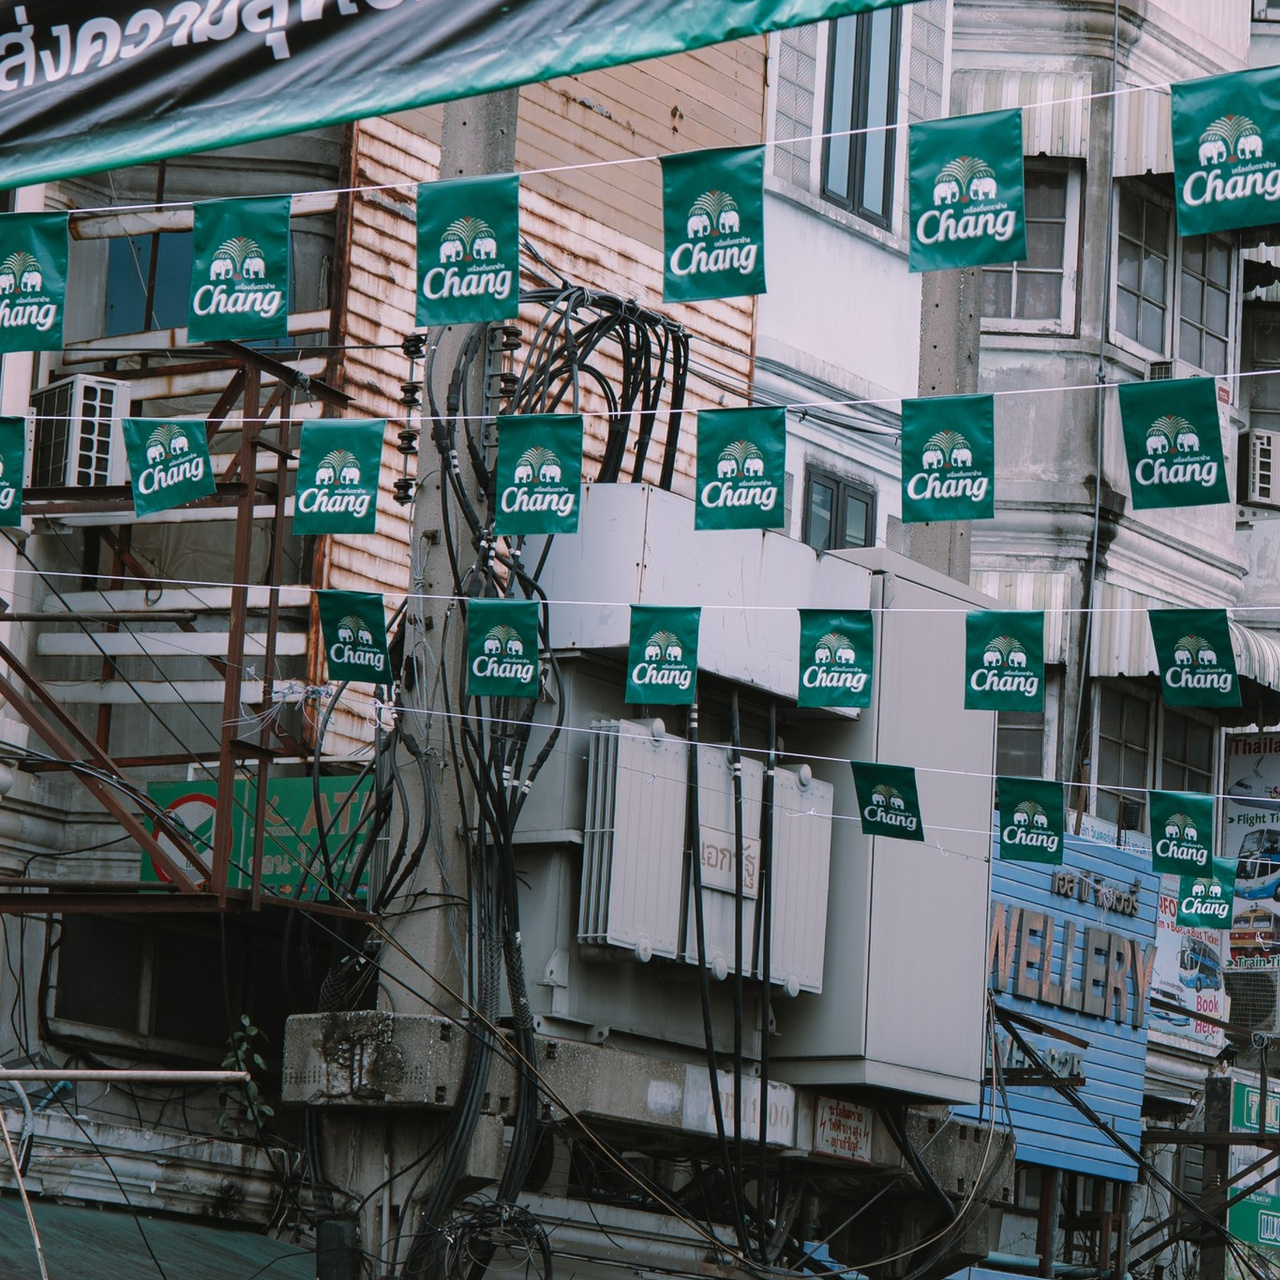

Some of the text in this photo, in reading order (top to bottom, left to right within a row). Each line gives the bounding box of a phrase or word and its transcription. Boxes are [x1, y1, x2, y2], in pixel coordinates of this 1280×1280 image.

[917, 209, 1015, 244] Chang
[670, 242, 757, 276] Chang
[423, 267, 512, 299] Chang
[194, 285, 281, 317] Chang
[138, 457, 205, 494] Chang
[1136, 459, 1217, 486] Chang
[701, 482, 777, 510] Chang
[907, 473, 988, 501] Chang
[299, 488, 371, 517] Chang
[502, 487, 575, 516] Chang
[331, 644, 384, 671] Chang
[632, 663, 692, 689] Chang
[803, 666, 867, 692] Chang
[1166, 667, 1232, 692] Chang
[864, 806, 916, 830] Chang
[1237, 813, 1266, 827] Flight
[1156, 839, 1207, 865] Chang
[1237, 955, 1267, 968] Train
[1196, 994, 1219, 1014] Book
